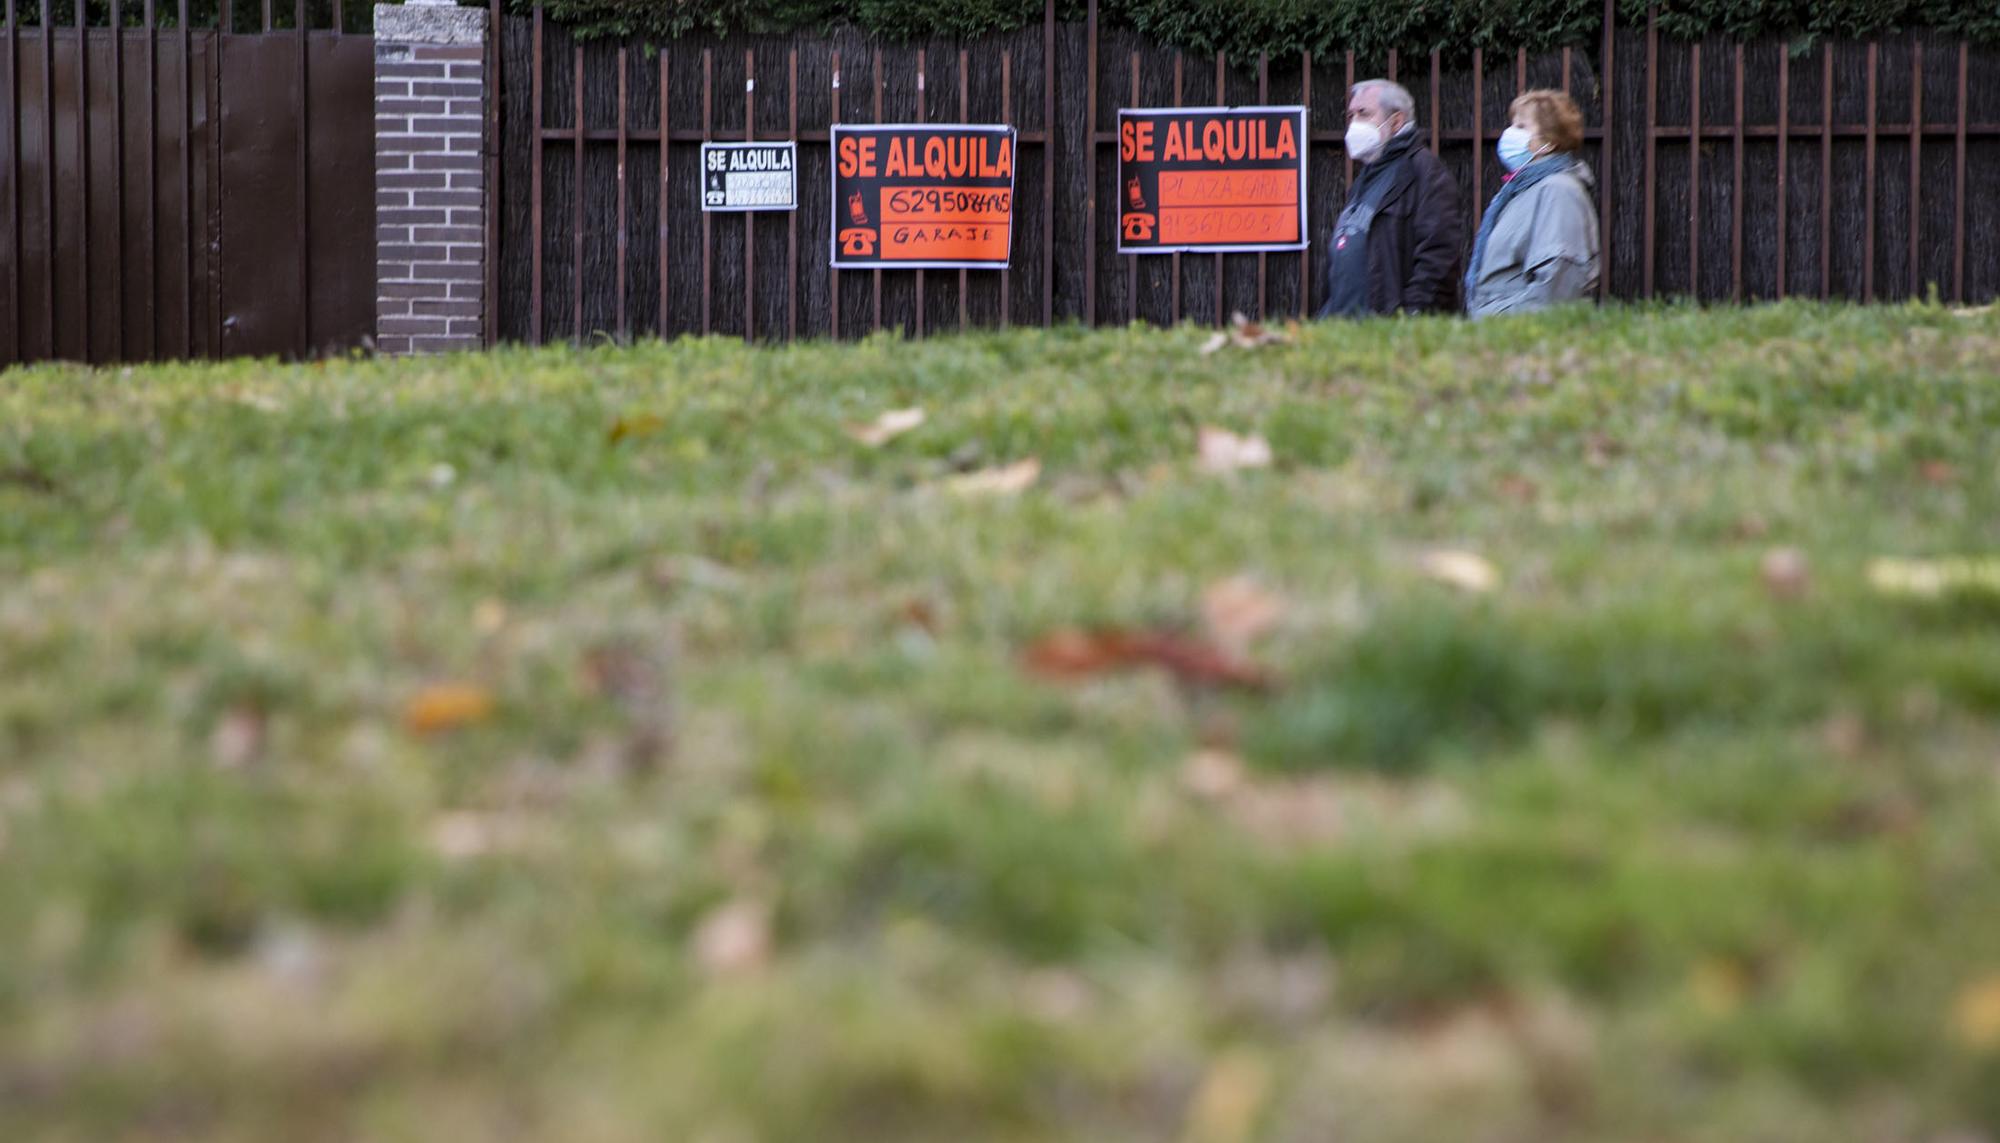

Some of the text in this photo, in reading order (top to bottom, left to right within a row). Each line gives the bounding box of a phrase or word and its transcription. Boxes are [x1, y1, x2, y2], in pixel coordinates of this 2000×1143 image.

[1122, 119, 1297, 164] SE ALQUILA
[708, 149, 791, 171] SE ALQUILA
[839, 136, 1012, 180] SE ALQUILA
[1161, 175, 1233, 204] PLAZA
[893, 227, 993, 244] GARAJE
